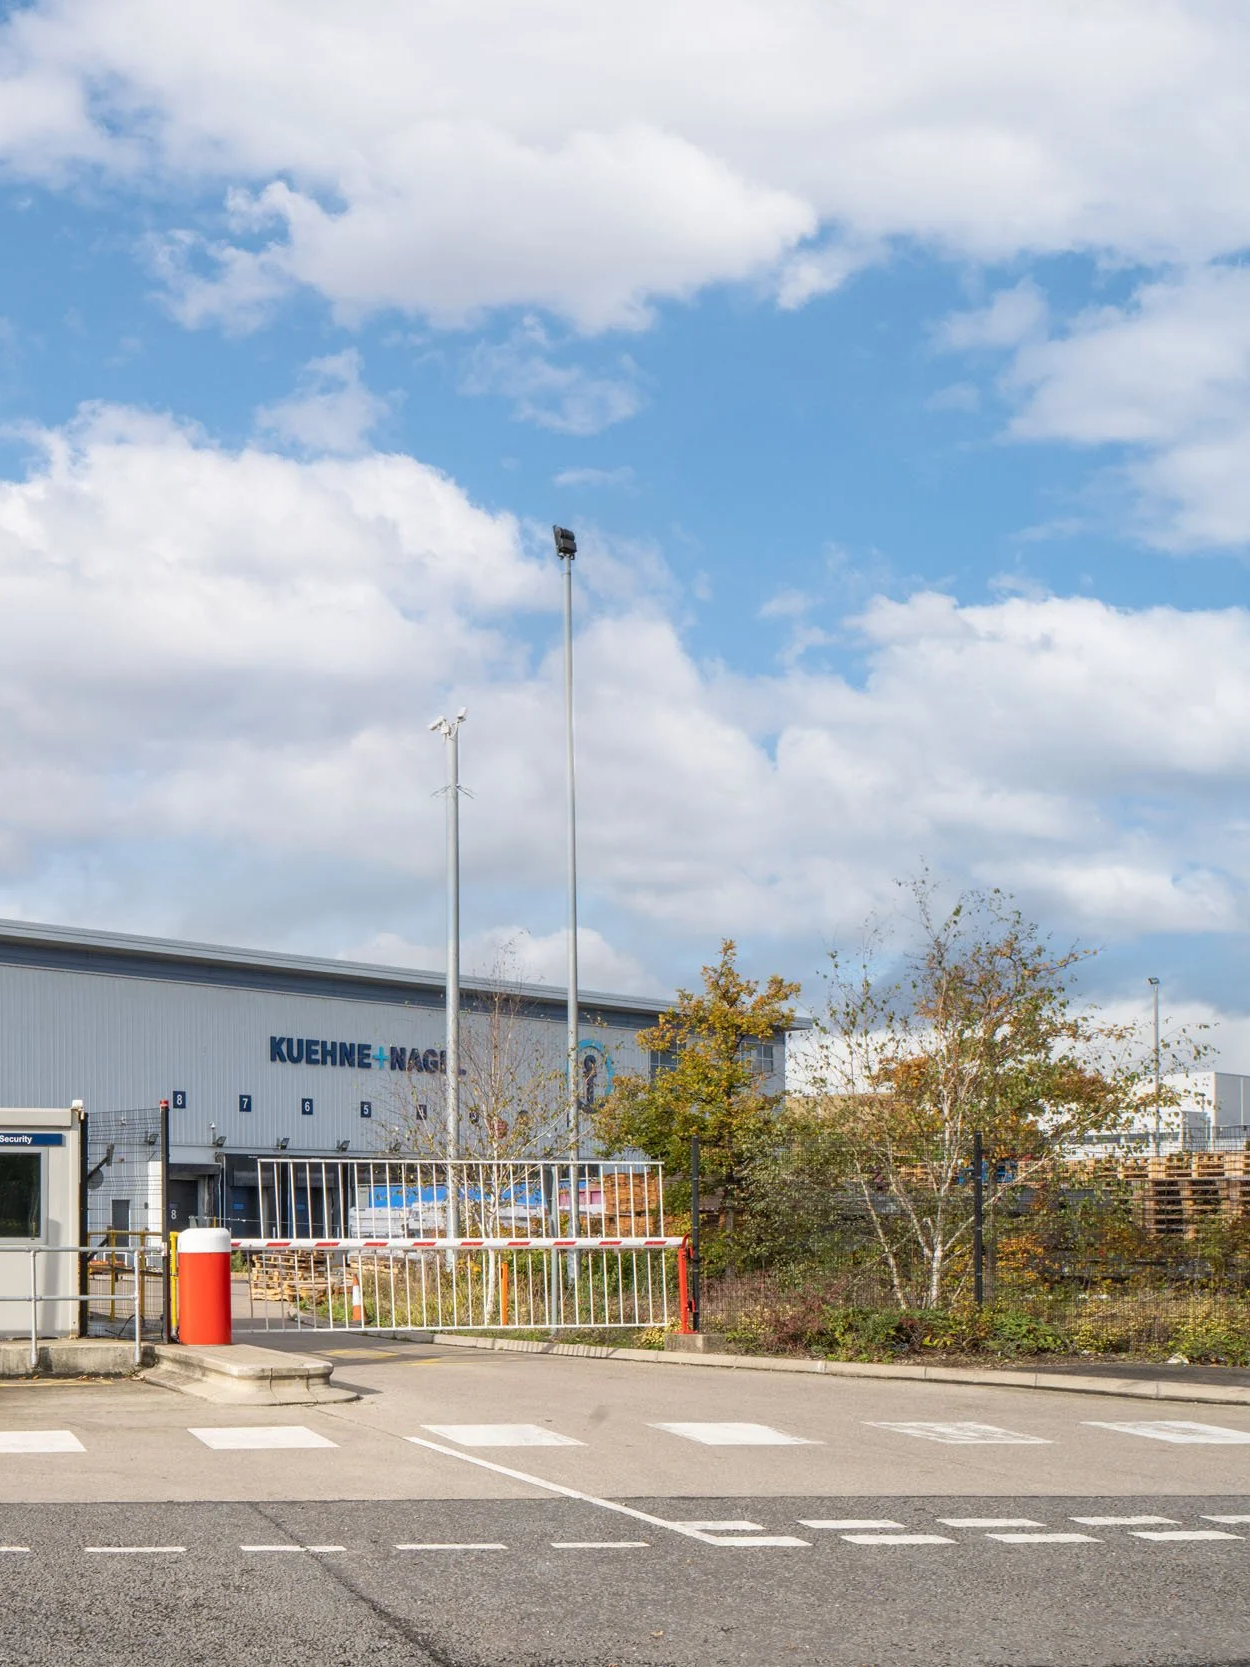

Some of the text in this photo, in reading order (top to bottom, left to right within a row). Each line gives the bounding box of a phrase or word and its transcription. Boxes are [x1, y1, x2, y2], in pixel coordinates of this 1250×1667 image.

[270, 1036, 466, 1075] KUEHNE+NAG
[176, 1094, 183, 1105] 8
[242, 1098, 248, 1109] 7
[304, 1101, 310, 1112] 6
[363, 1104, 369, 1115] 5
[171, 1209, 177, 1220] 8
